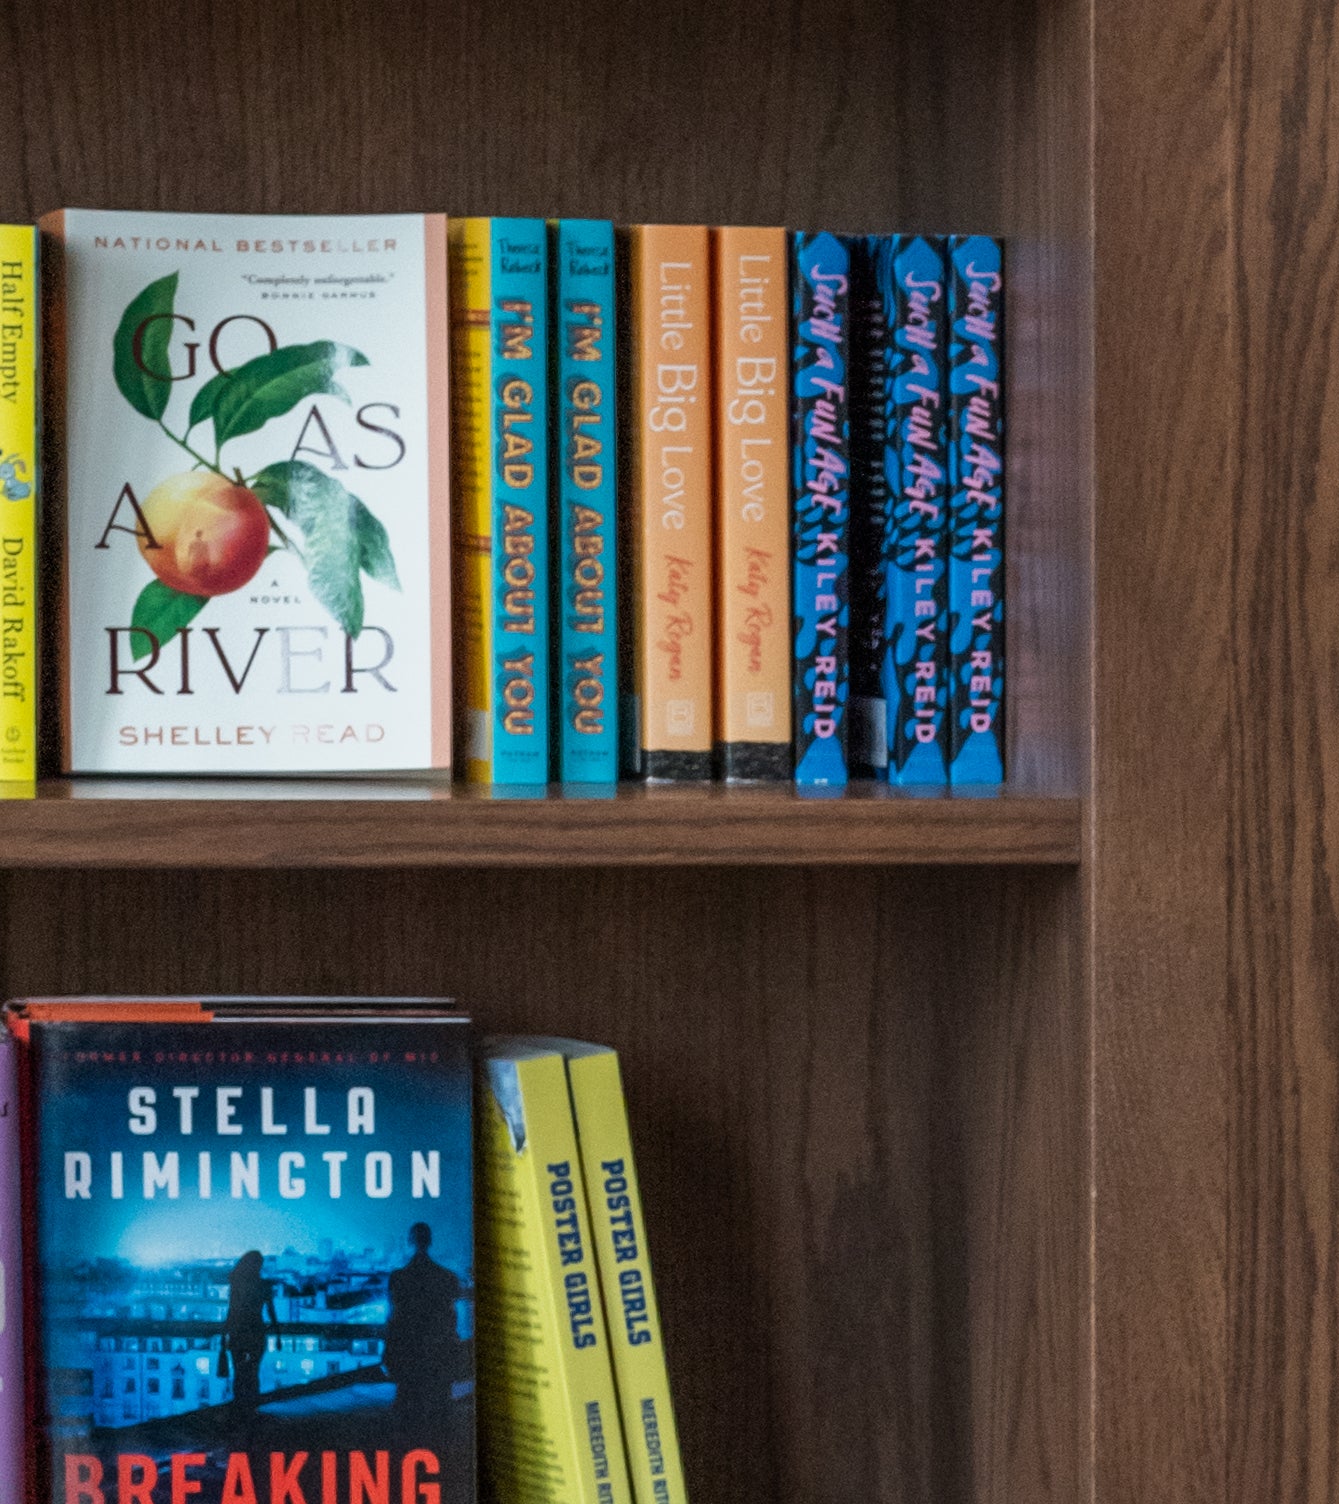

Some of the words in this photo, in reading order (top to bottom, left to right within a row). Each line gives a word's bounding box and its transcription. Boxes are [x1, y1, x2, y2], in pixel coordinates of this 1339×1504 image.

[94, 236, 223, 253] NATIONAL
[236, 239, 397, 253] BESTSELLER
[1, 259, 24, 321] Half
[659, 261, 693, 351] Little
[132, 313, 278, 381] GO
[499, 300, 533, 358] I'M
[649, 362, 697, 432] Big
[289, 404, 406, 470] AS
[500, 380, 533, 489] GLAD
[94, 482, 162, 549] A
[661, 446, 693, 531] Love
[2, 537, 24, 603] David
[249, 596, 302, 604] NOVEL
[502, 505, 534, 634] ABOUT
[971, 528, 992, 631] KILEY
[3, 614, 25, 703] Rakoff
[104, 625, 399, 695] RIVER
[502, 649, 535, 735] YOU
[970, 649, 991, 734] REID
[118, 725, 277, 747] SHELLEY
[293, 723, 386, 745] READ
[128, 1086, 376, 1135] STELLA
[64, 1150, 441, 1199] RIMINGTON
[547, 1160, 584, 1267] POSTER
[564, 1272, 597, 1350] GIRLS
[585, 1401, 610, 1479] MEREDITH
